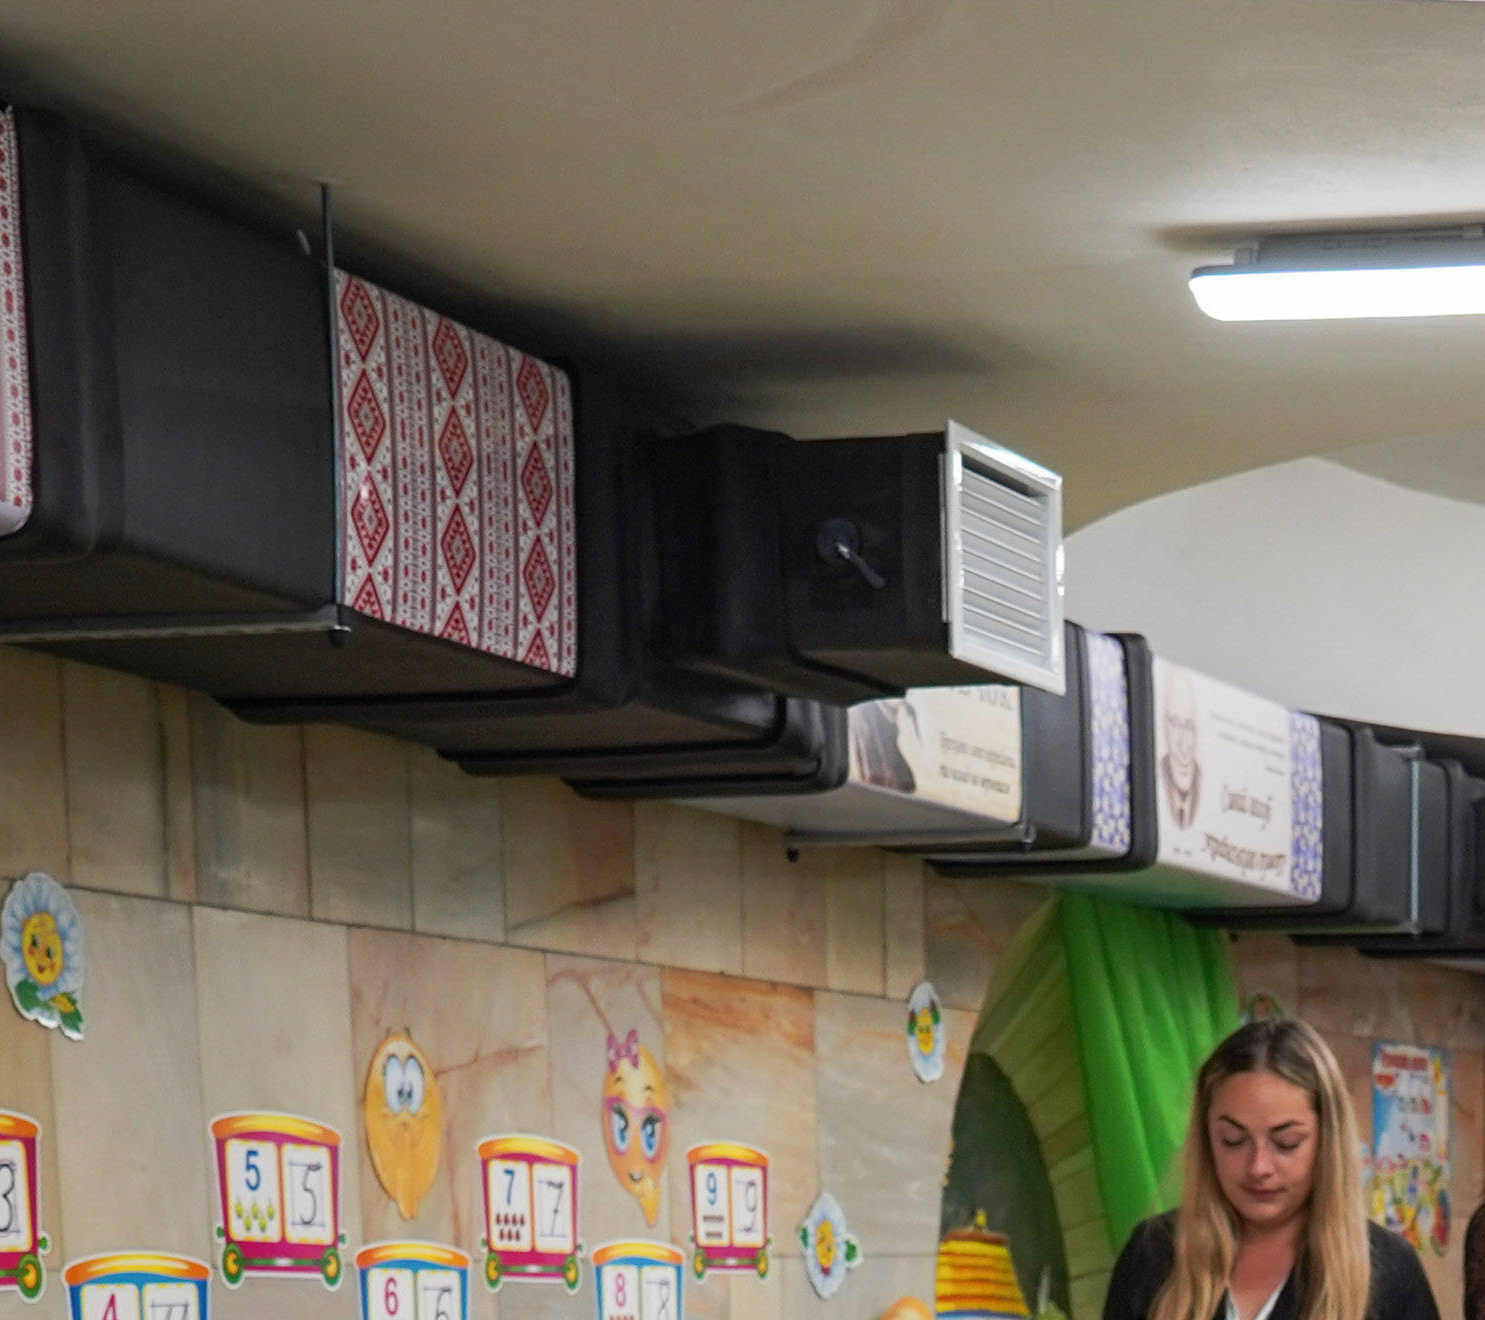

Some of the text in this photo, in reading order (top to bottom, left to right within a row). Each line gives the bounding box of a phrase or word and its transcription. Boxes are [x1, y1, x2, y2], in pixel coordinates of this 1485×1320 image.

[245, 1150, 260, 1191] 5
[502, 1169, 516, 1206] 7
[707, 1171, 718, 1206] 9
[384, 1277, 399, 1316] 6
[614, 1273, 627, 1308] 8
